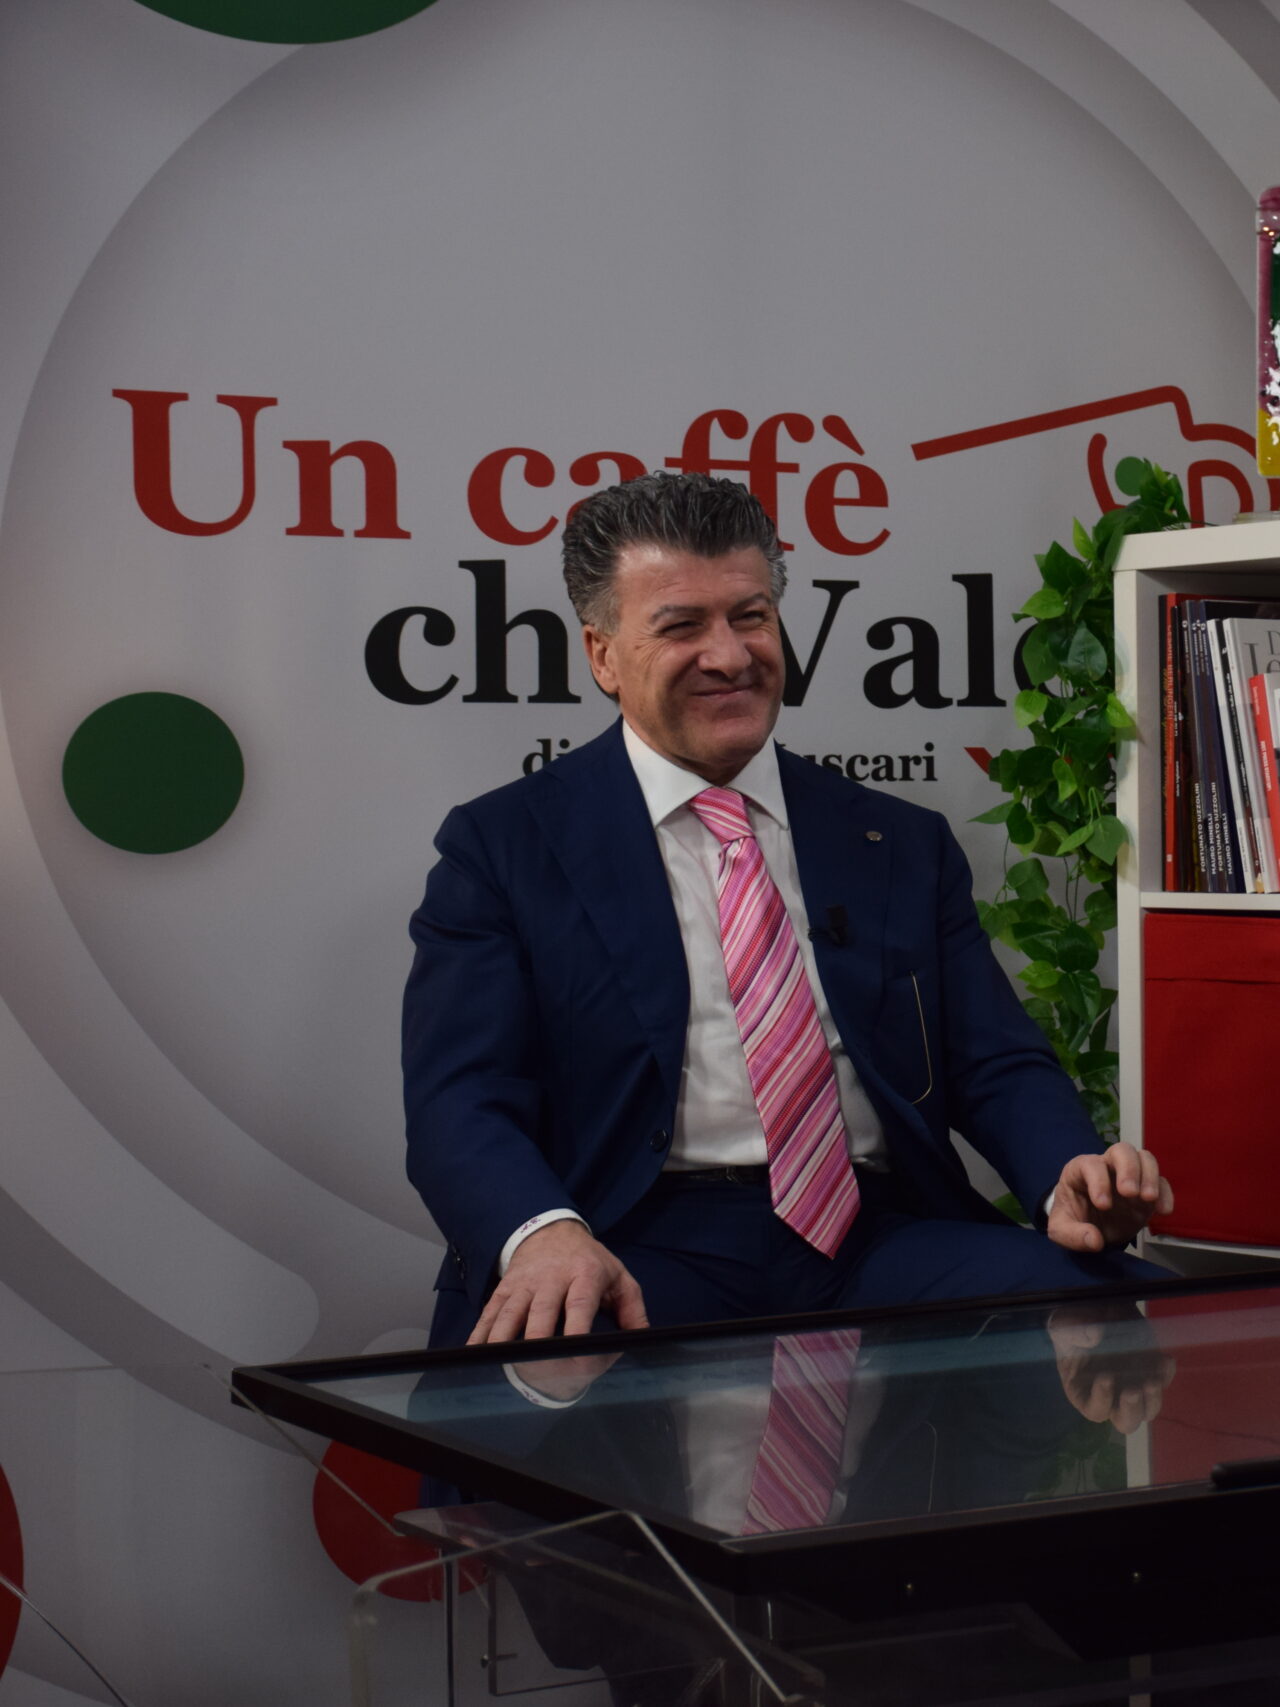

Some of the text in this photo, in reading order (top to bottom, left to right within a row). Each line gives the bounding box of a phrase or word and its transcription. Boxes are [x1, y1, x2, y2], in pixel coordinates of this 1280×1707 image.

[112, 389, 412, 541] Un
[364, 559, 582, 706] ch
[778, 742, 938, 782] scari
[1198, 823, 1206, 872] FORTUNATO
[1215, 823, 1224, 872] FORTUNATO
[1225, 845, 1233, 875] MAURO
